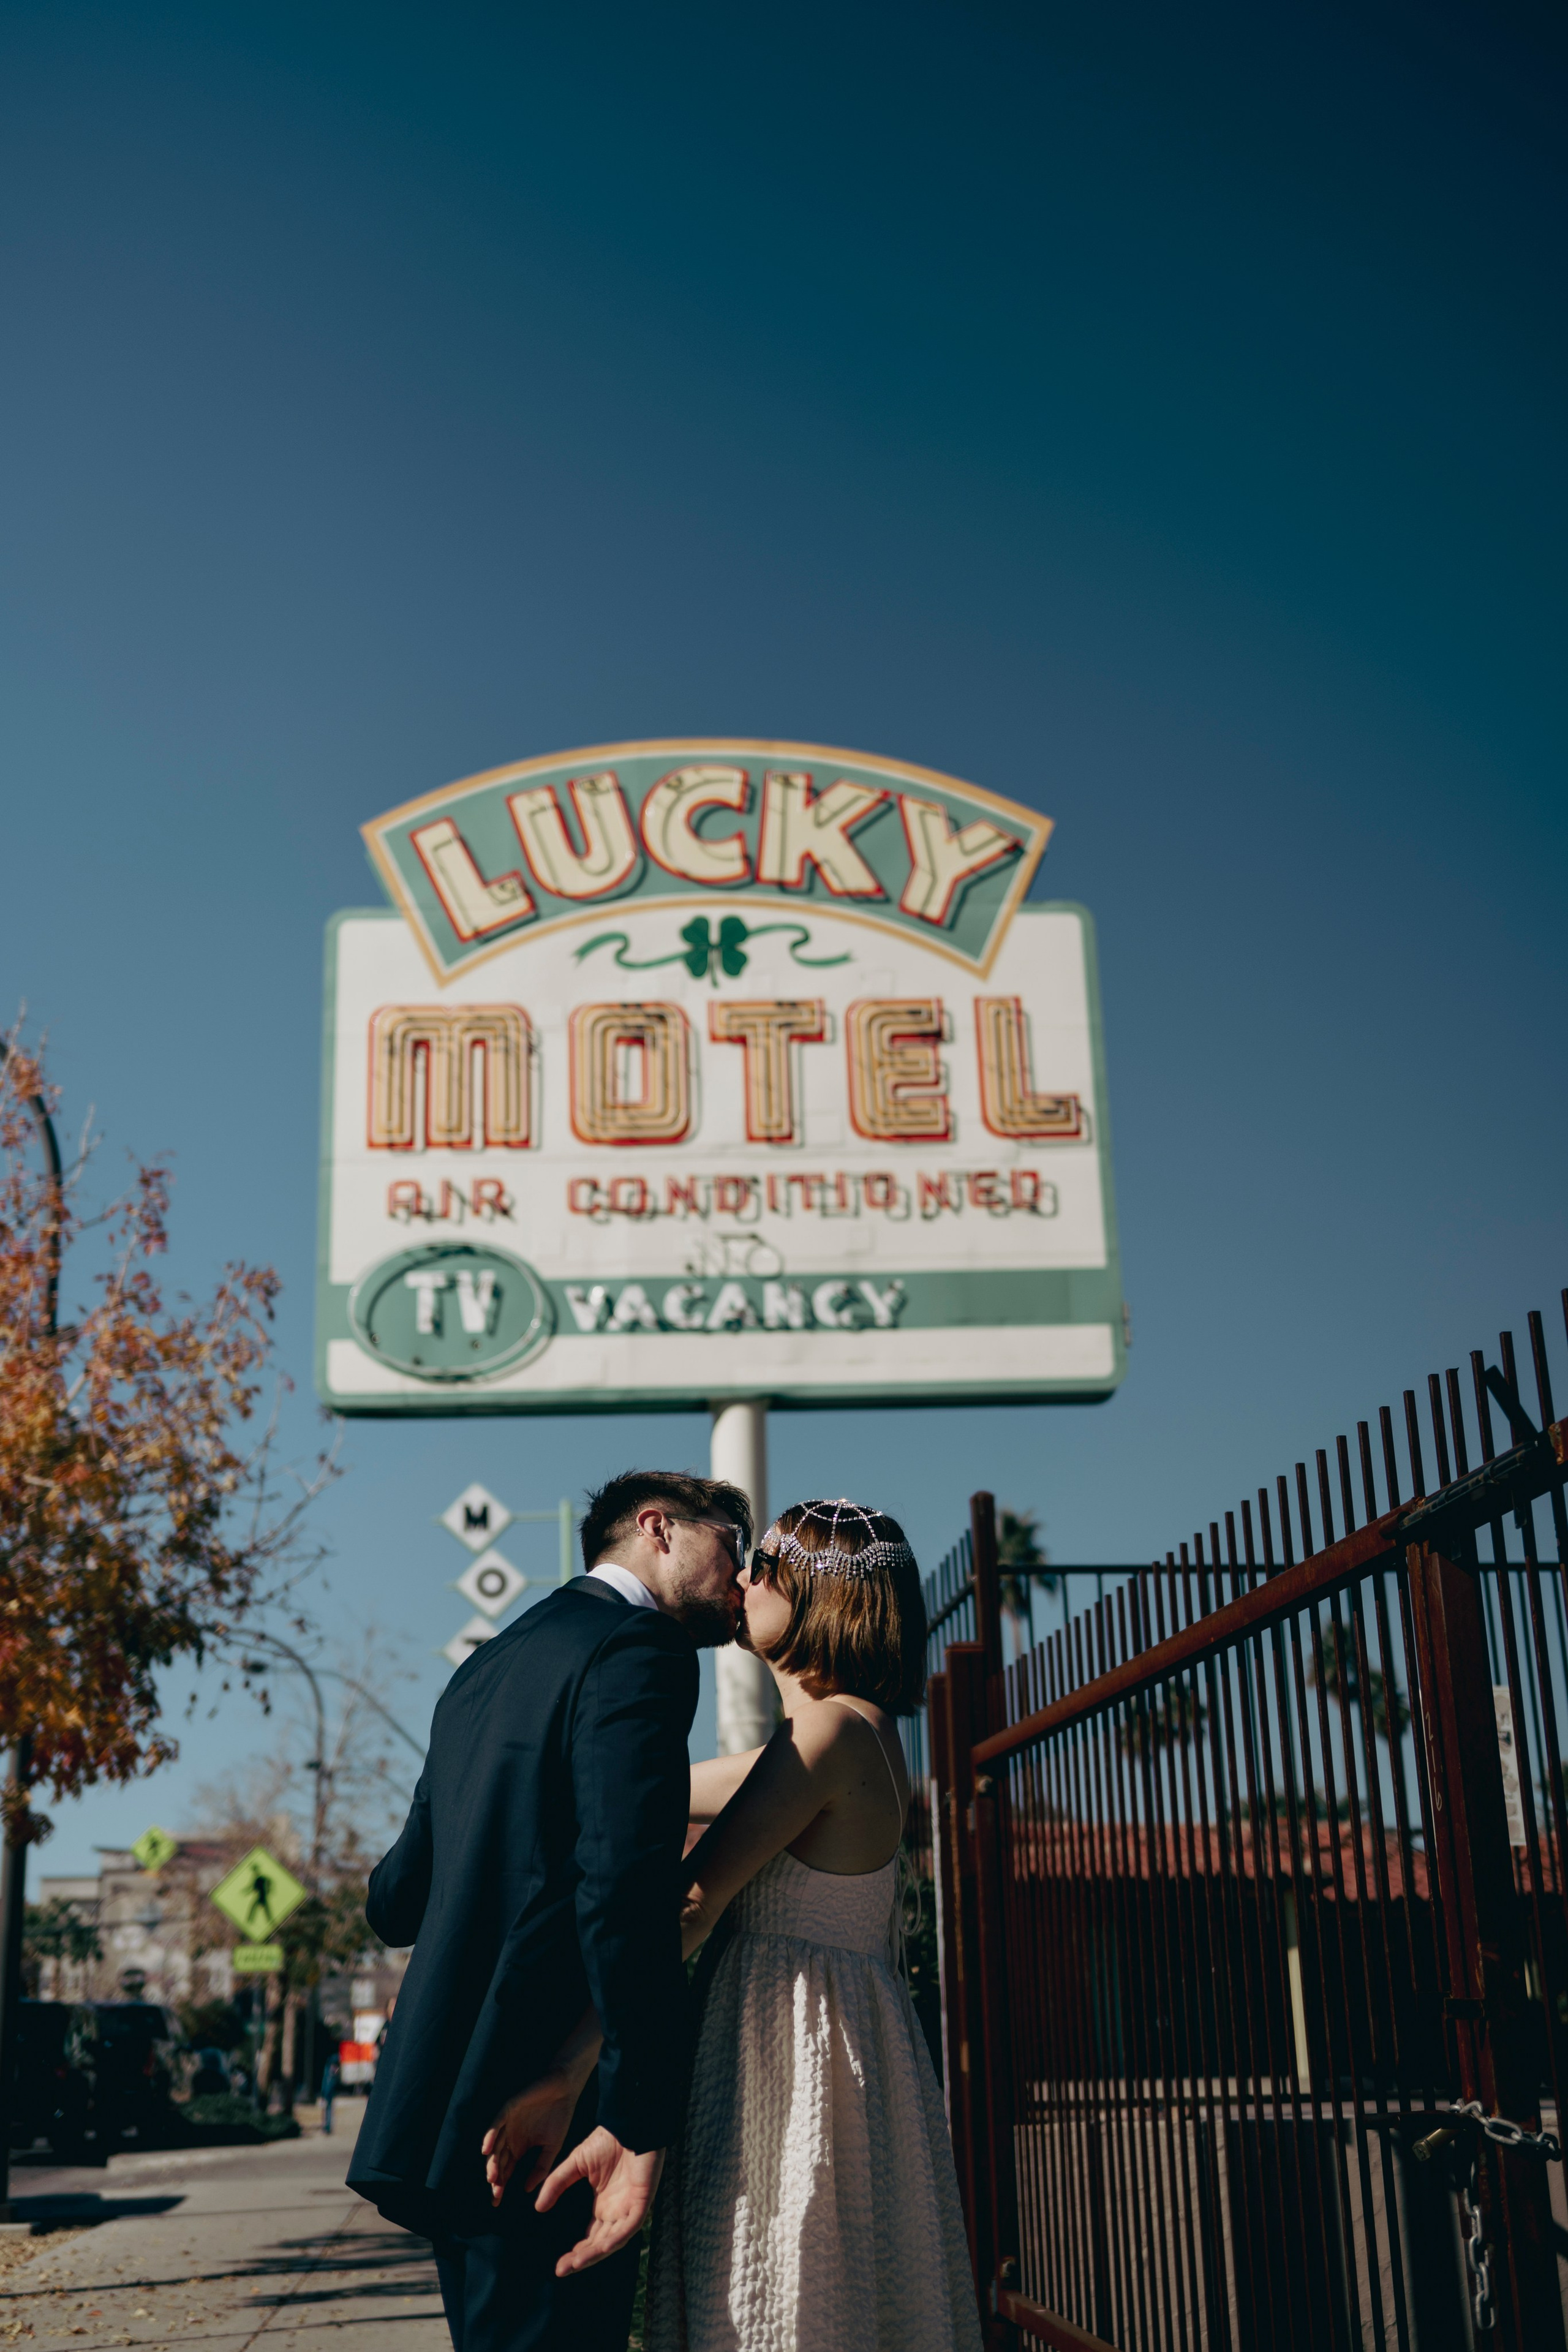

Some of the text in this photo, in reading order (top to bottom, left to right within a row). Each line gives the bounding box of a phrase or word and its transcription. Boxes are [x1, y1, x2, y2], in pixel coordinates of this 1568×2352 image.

[409, 764, 1025, 944] LUCKY
[366, 996, 1083, 1150] MOTEL
[388, 1169, 1043, 1219] AIR CONDITIONED
[404, 1268, 497, 1335] TV
[563, 1279, 907, 1332] VACANCY
